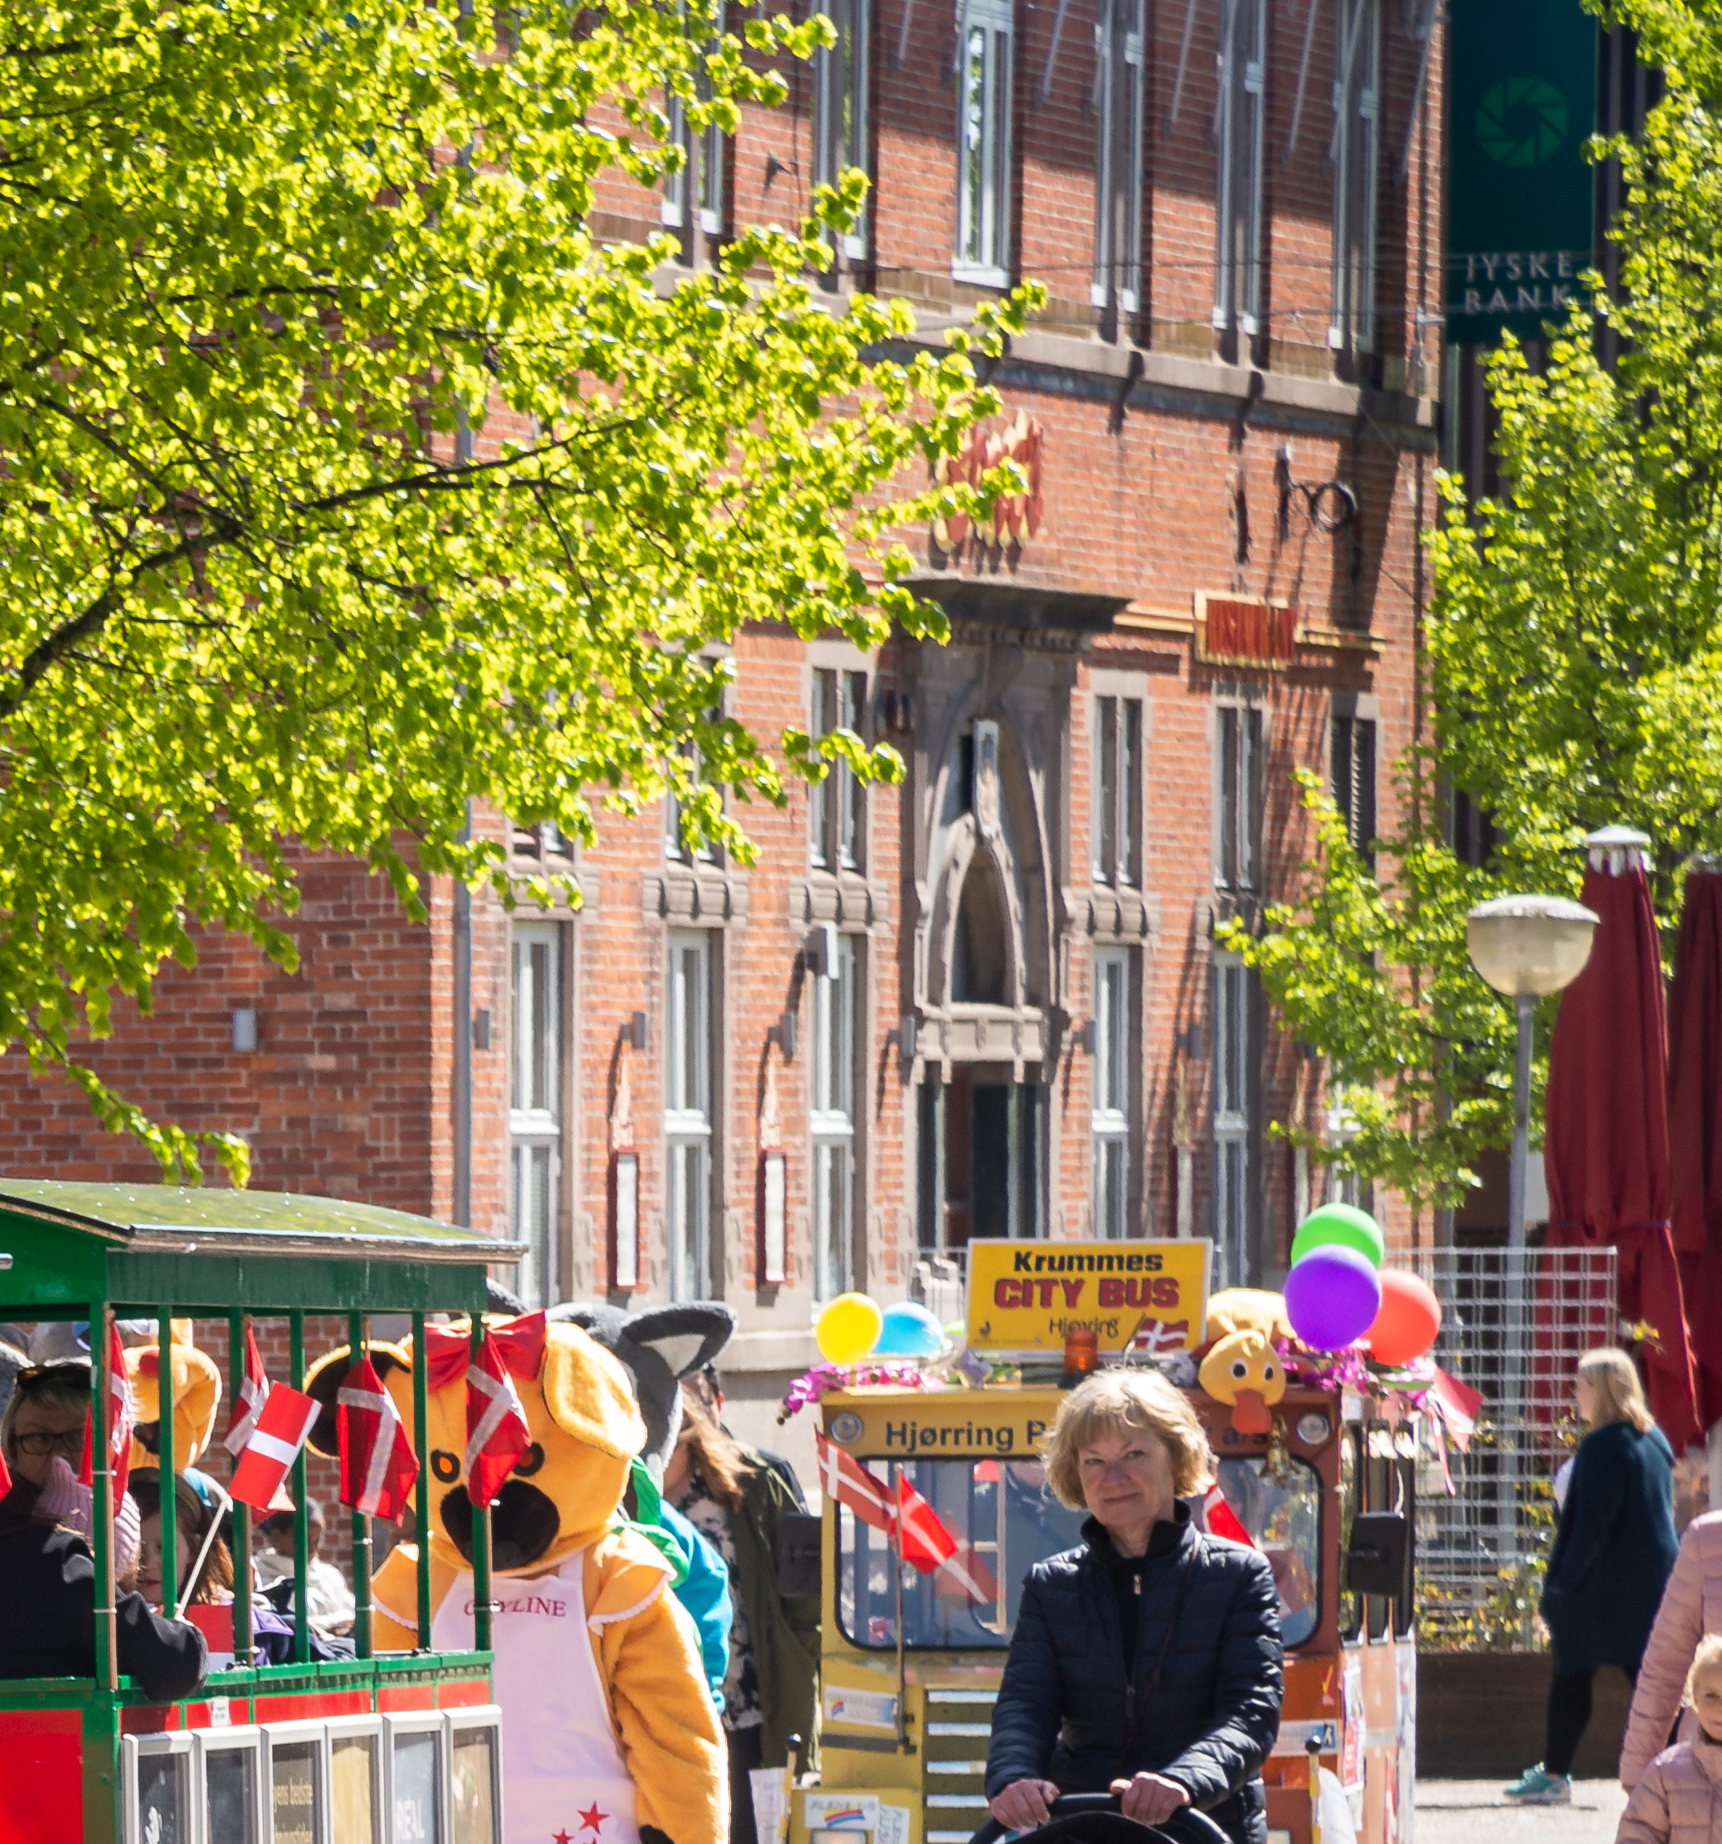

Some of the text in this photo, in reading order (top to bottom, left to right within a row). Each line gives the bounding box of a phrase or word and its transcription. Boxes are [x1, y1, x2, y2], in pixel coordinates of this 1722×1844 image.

[1466, 250, 1573, 283] JYSKE
[1465, 284, 1572, 315] BANK
[1014, 1251, 1163, 1272] Krummes
[993, 1277, 1179, 1309] CITY BUS
[886, 1420, 1013, 1452] Hjørring
[464, 1596, 567, 1618] CYLINE
